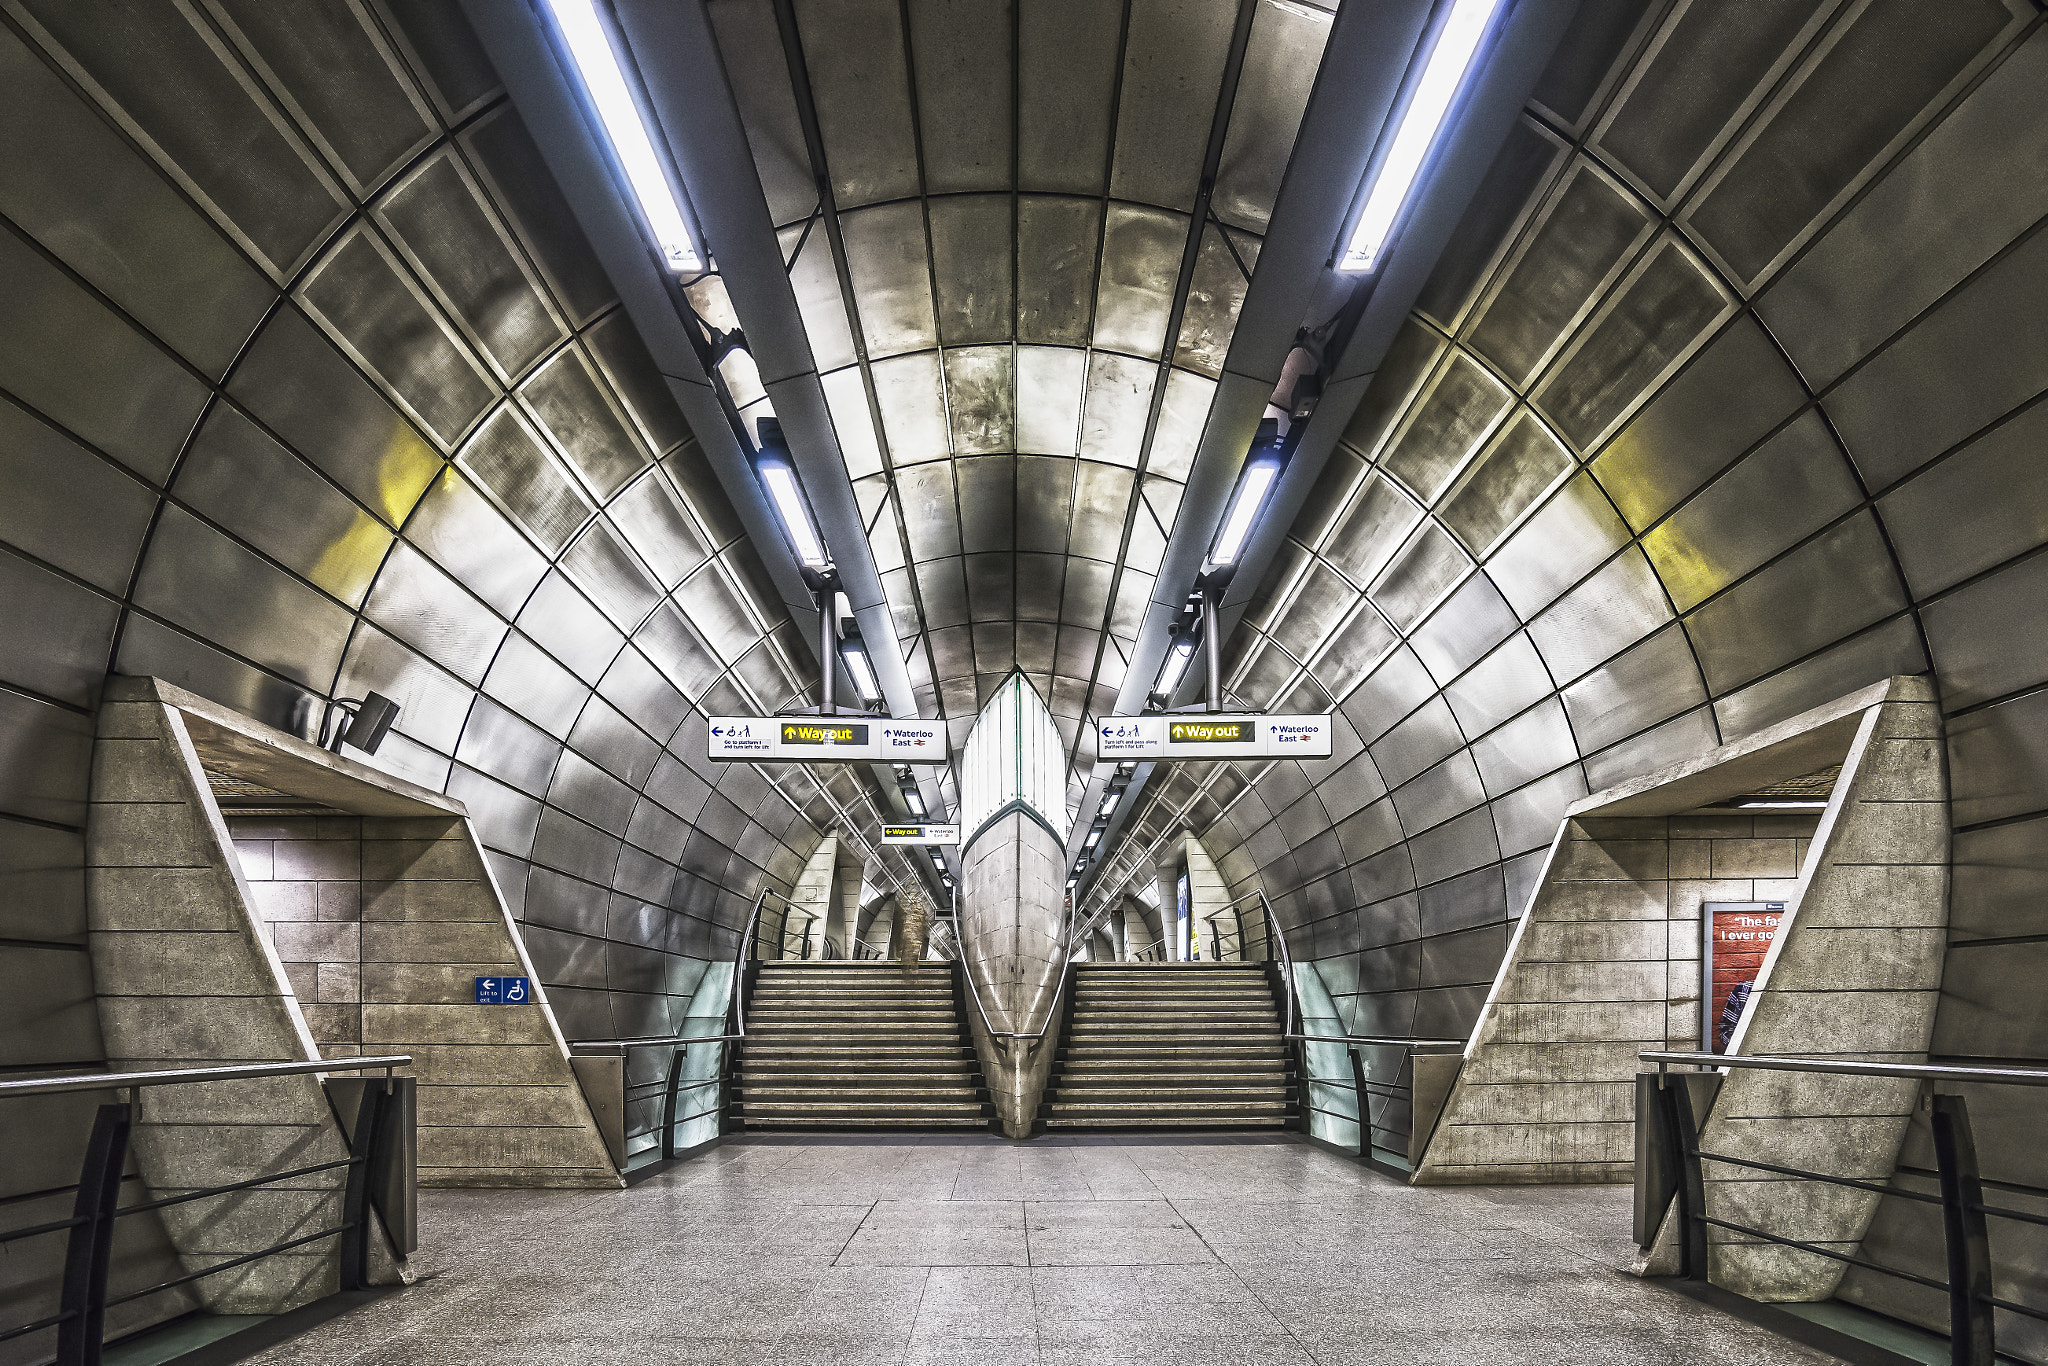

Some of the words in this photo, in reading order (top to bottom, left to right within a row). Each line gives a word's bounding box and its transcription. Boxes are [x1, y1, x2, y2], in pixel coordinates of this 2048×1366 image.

[798, 727, 825, 741] Way
[831, 727, 853, 740] out
[893, 729, 933, 738] Waterloo
[1186, 725, 1213, 740] Way
[1216, 725, 1239, 737] out
[1279, 725, 1319, 733] Waterloo
[1721, 930, 1725, 940] I
[1728, 931, 1755, 940] ever
